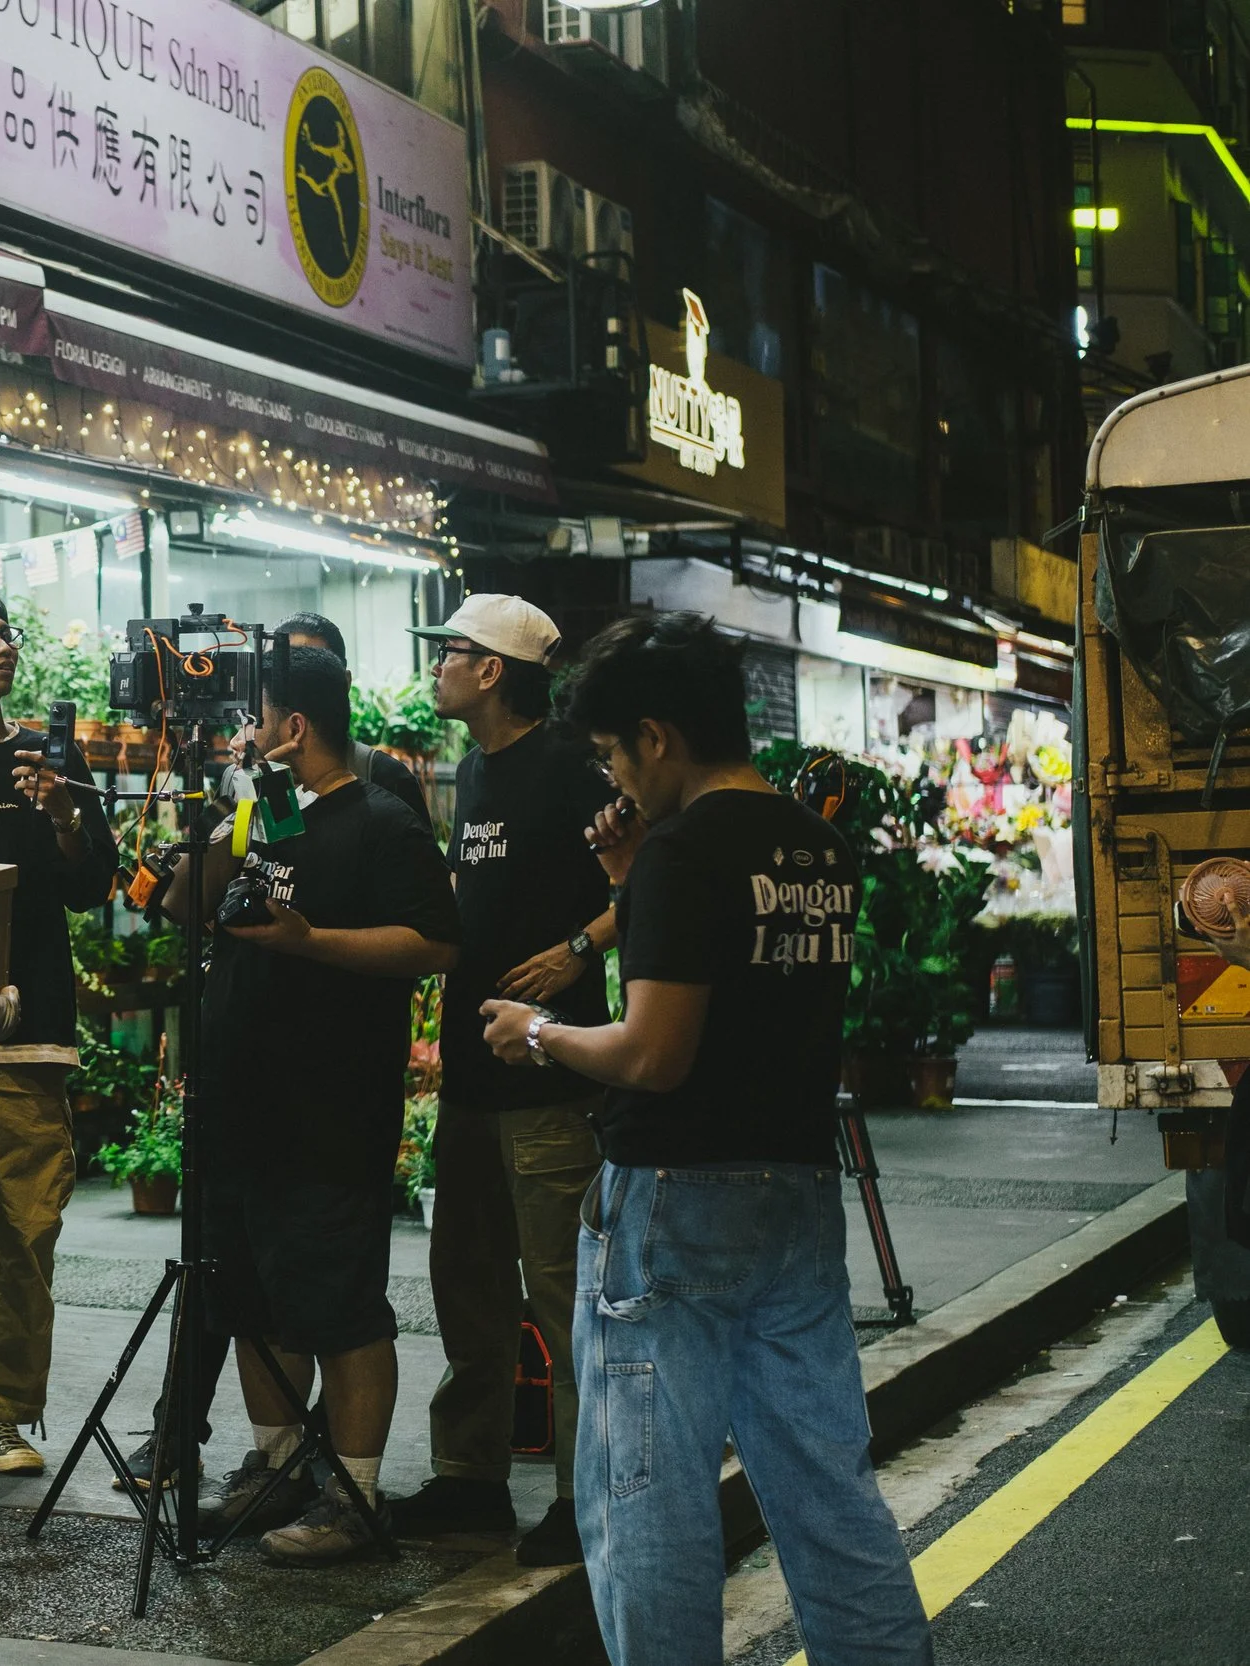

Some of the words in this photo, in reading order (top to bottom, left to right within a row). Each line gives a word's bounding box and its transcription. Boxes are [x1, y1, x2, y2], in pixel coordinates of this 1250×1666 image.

[377, 175, 451, 240] Interflora
[0, 304, 18, 329] PM
[54, 338, 93, 366] FLORAL
[92, 349, 127, 377] DESIGN
[142, 365, 213, 401] ARRANGEMENTS
[225, 389, 263, 414] OPENING
[462, 820, 505, 843] Dengar
[460, 843, 487, 865] Lagu
[488, 839, 508, 858] Ini
[272, 880, 295, 901] Ini
[750, 873, 854, 927] Dengar
[750, 924, 820, 978] Lagu
